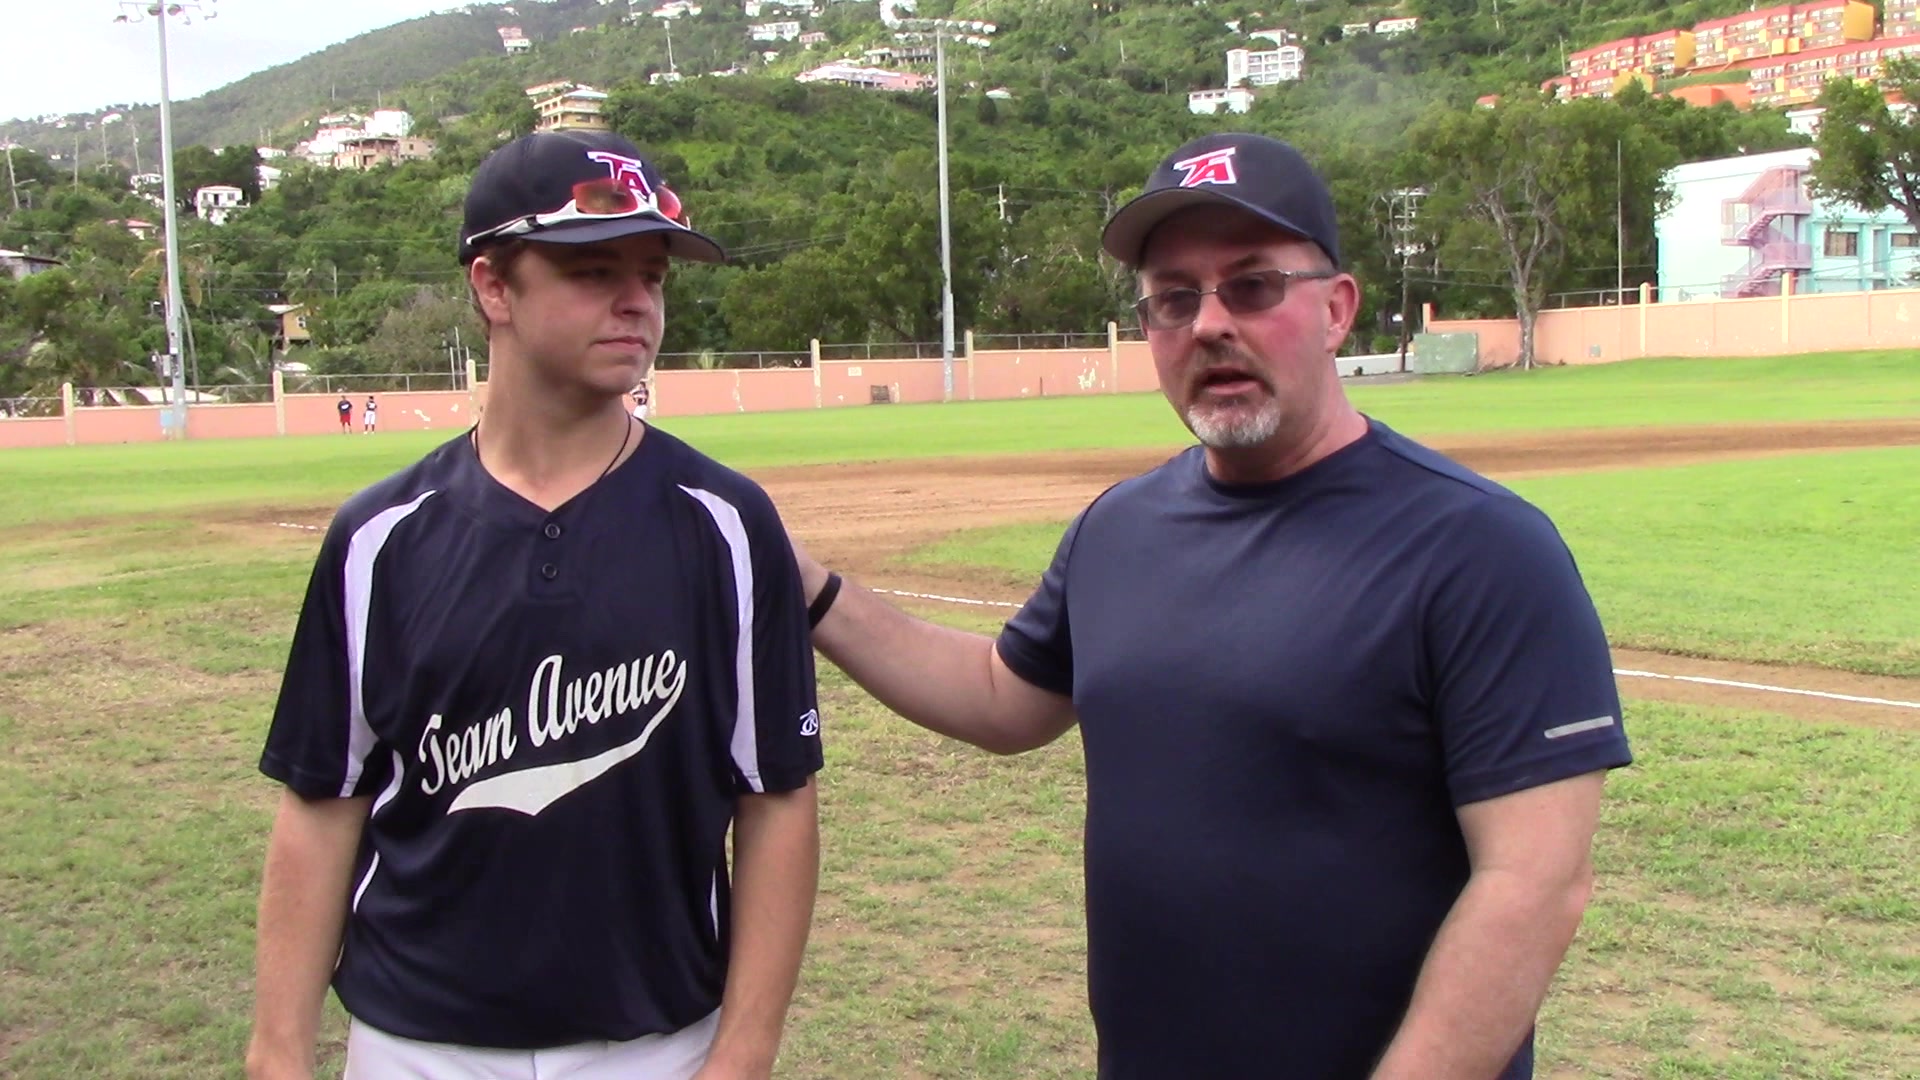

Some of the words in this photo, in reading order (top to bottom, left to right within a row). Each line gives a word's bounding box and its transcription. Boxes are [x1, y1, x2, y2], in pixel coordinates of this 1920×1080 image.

[586, 151, 653, 203] TA
[1173, 146, 1237, 188] TA
[418, 707, 517, 795] Team
[528, 649, 686, 748] Avenue
